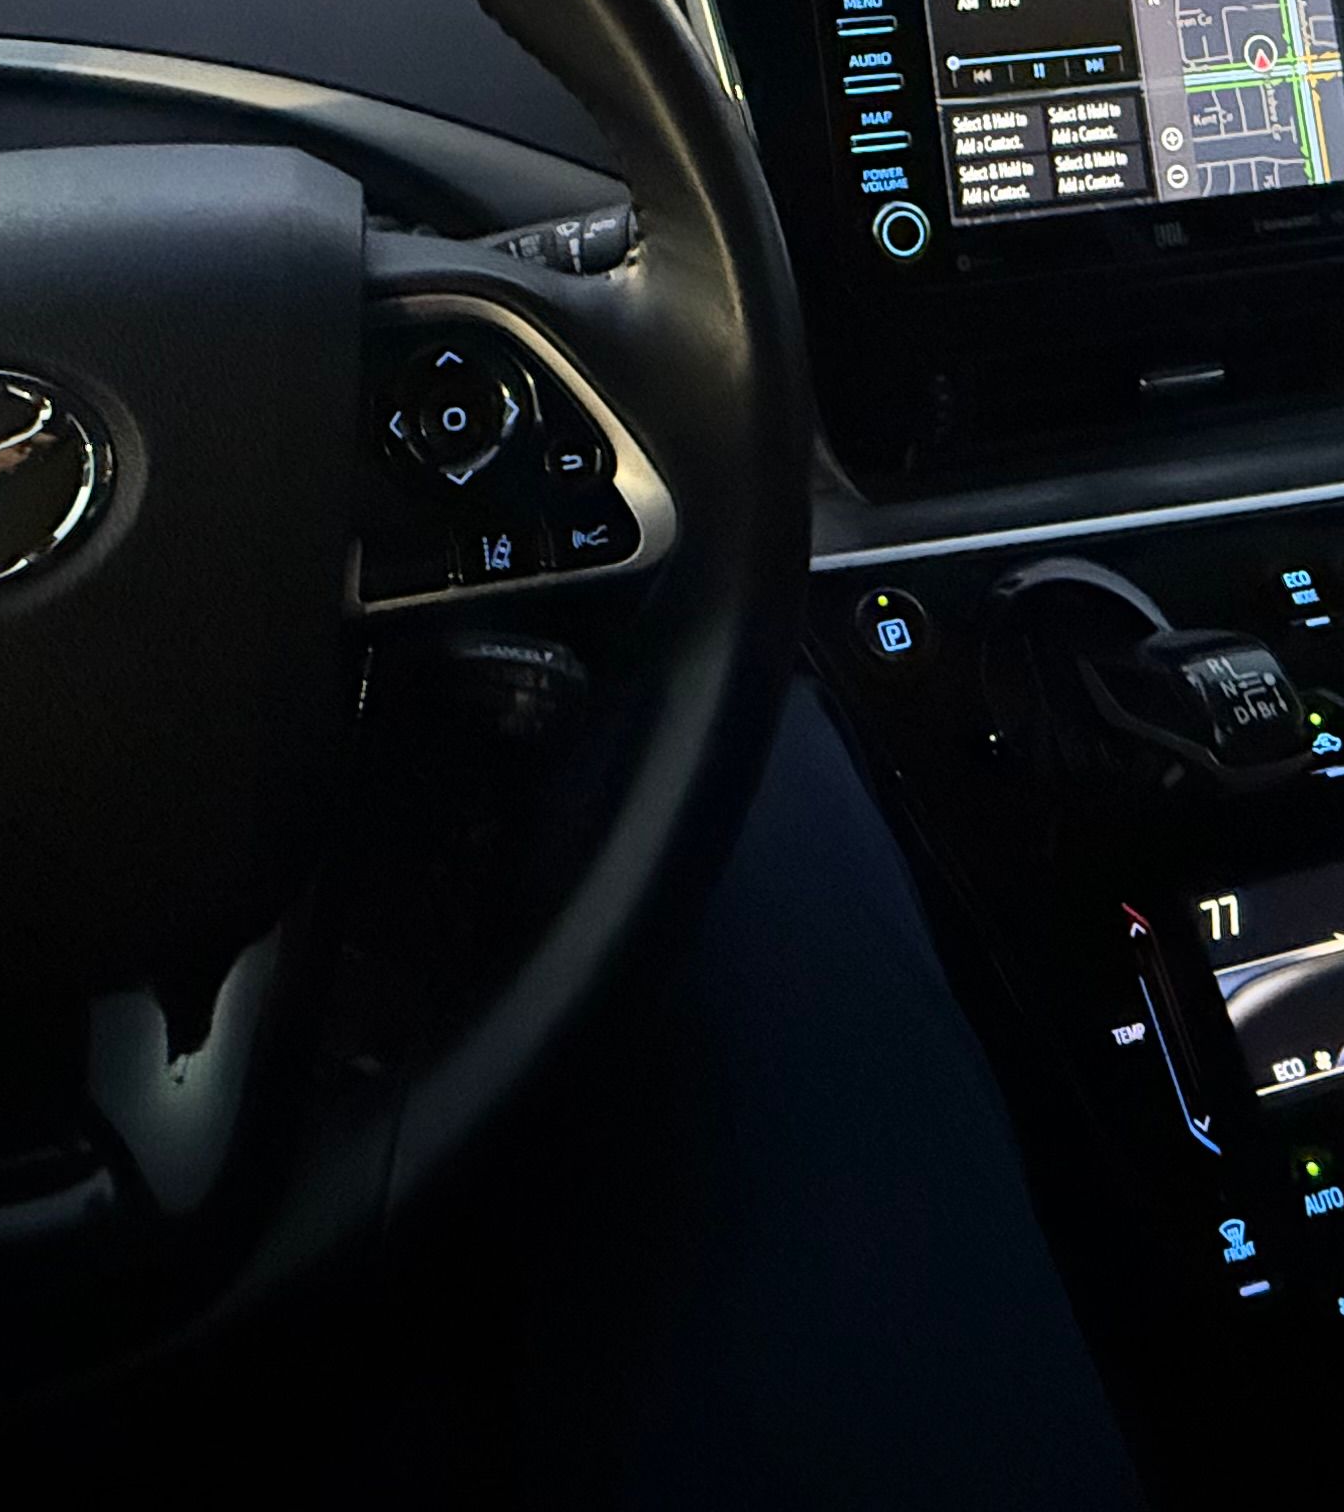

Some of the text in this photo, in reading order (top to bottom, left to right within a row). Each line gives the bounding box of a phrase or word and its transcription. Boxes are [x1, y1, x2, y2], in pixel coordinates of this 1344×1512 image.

[849, 52, 892, 67] AUDIO
[861, 111, 893, 125] MAP
[953, 116, 983, 133] Select
[993, 112, 1014, 129] Hold
[1015, 112, 1027, 127] to
[1048, 107, 1076, 124] Select
[1086, 102, 1109, 120] Hold
[1109, 104, 1121, 118] to
[1052, 128, 1071, 145] Add
[956, 139, 975, 155] Add
[1054, 155, 1083, 172] Select
[1093, 151, 1115, 168] Hold
[1116, 152, 1128, 166] to
[863, 167, 904, 180] POWER
[959, 166, 988, 183] Select
[999, 161, 1021, 178] Hold
[1022, 162, 1034, 176] to
[861, 178, 909, 193] VOLUME
[1058, 177, 1077, 193] Add
[963, 188, 982, 205] Add
[1283, 570, 1312, 588] ECO
[1207, 658, 1225, 675] R
[1220, 680, 1239, 699] N
[1233, 705, 1251, 726] D
[1199, 894, 1240, 941] 77
[1112, 1022, 1147, 1046] TEMP
[1272, 1057, 1306, 1084] ECO
[1304, 1186, 1344, 1217] AUTO
[1223, 1240, 1256, 1264] FRONT
